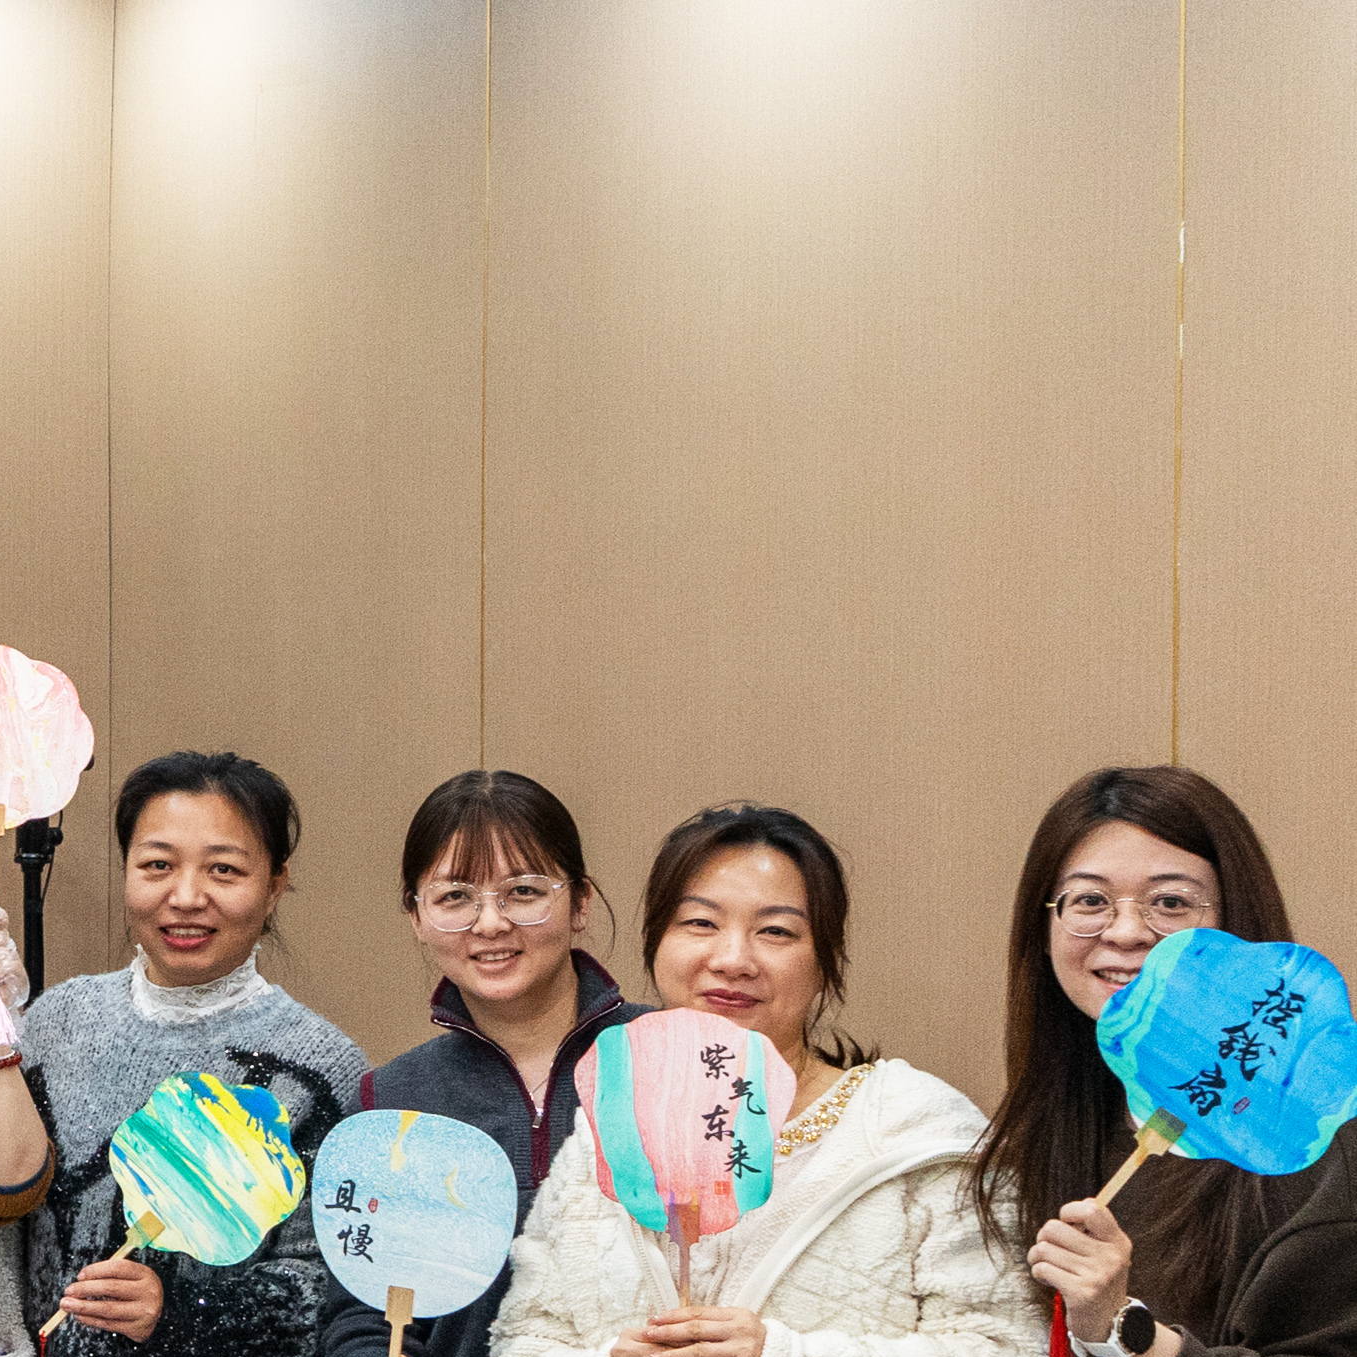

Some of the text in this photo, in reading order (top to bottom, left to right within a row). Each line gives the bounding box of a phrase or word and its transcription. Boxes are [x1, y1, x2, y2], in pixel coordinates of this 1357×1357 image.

[700, 1043, 766, 1179] 紫气东来
[325, 1179, 375, 1264] 且慢
